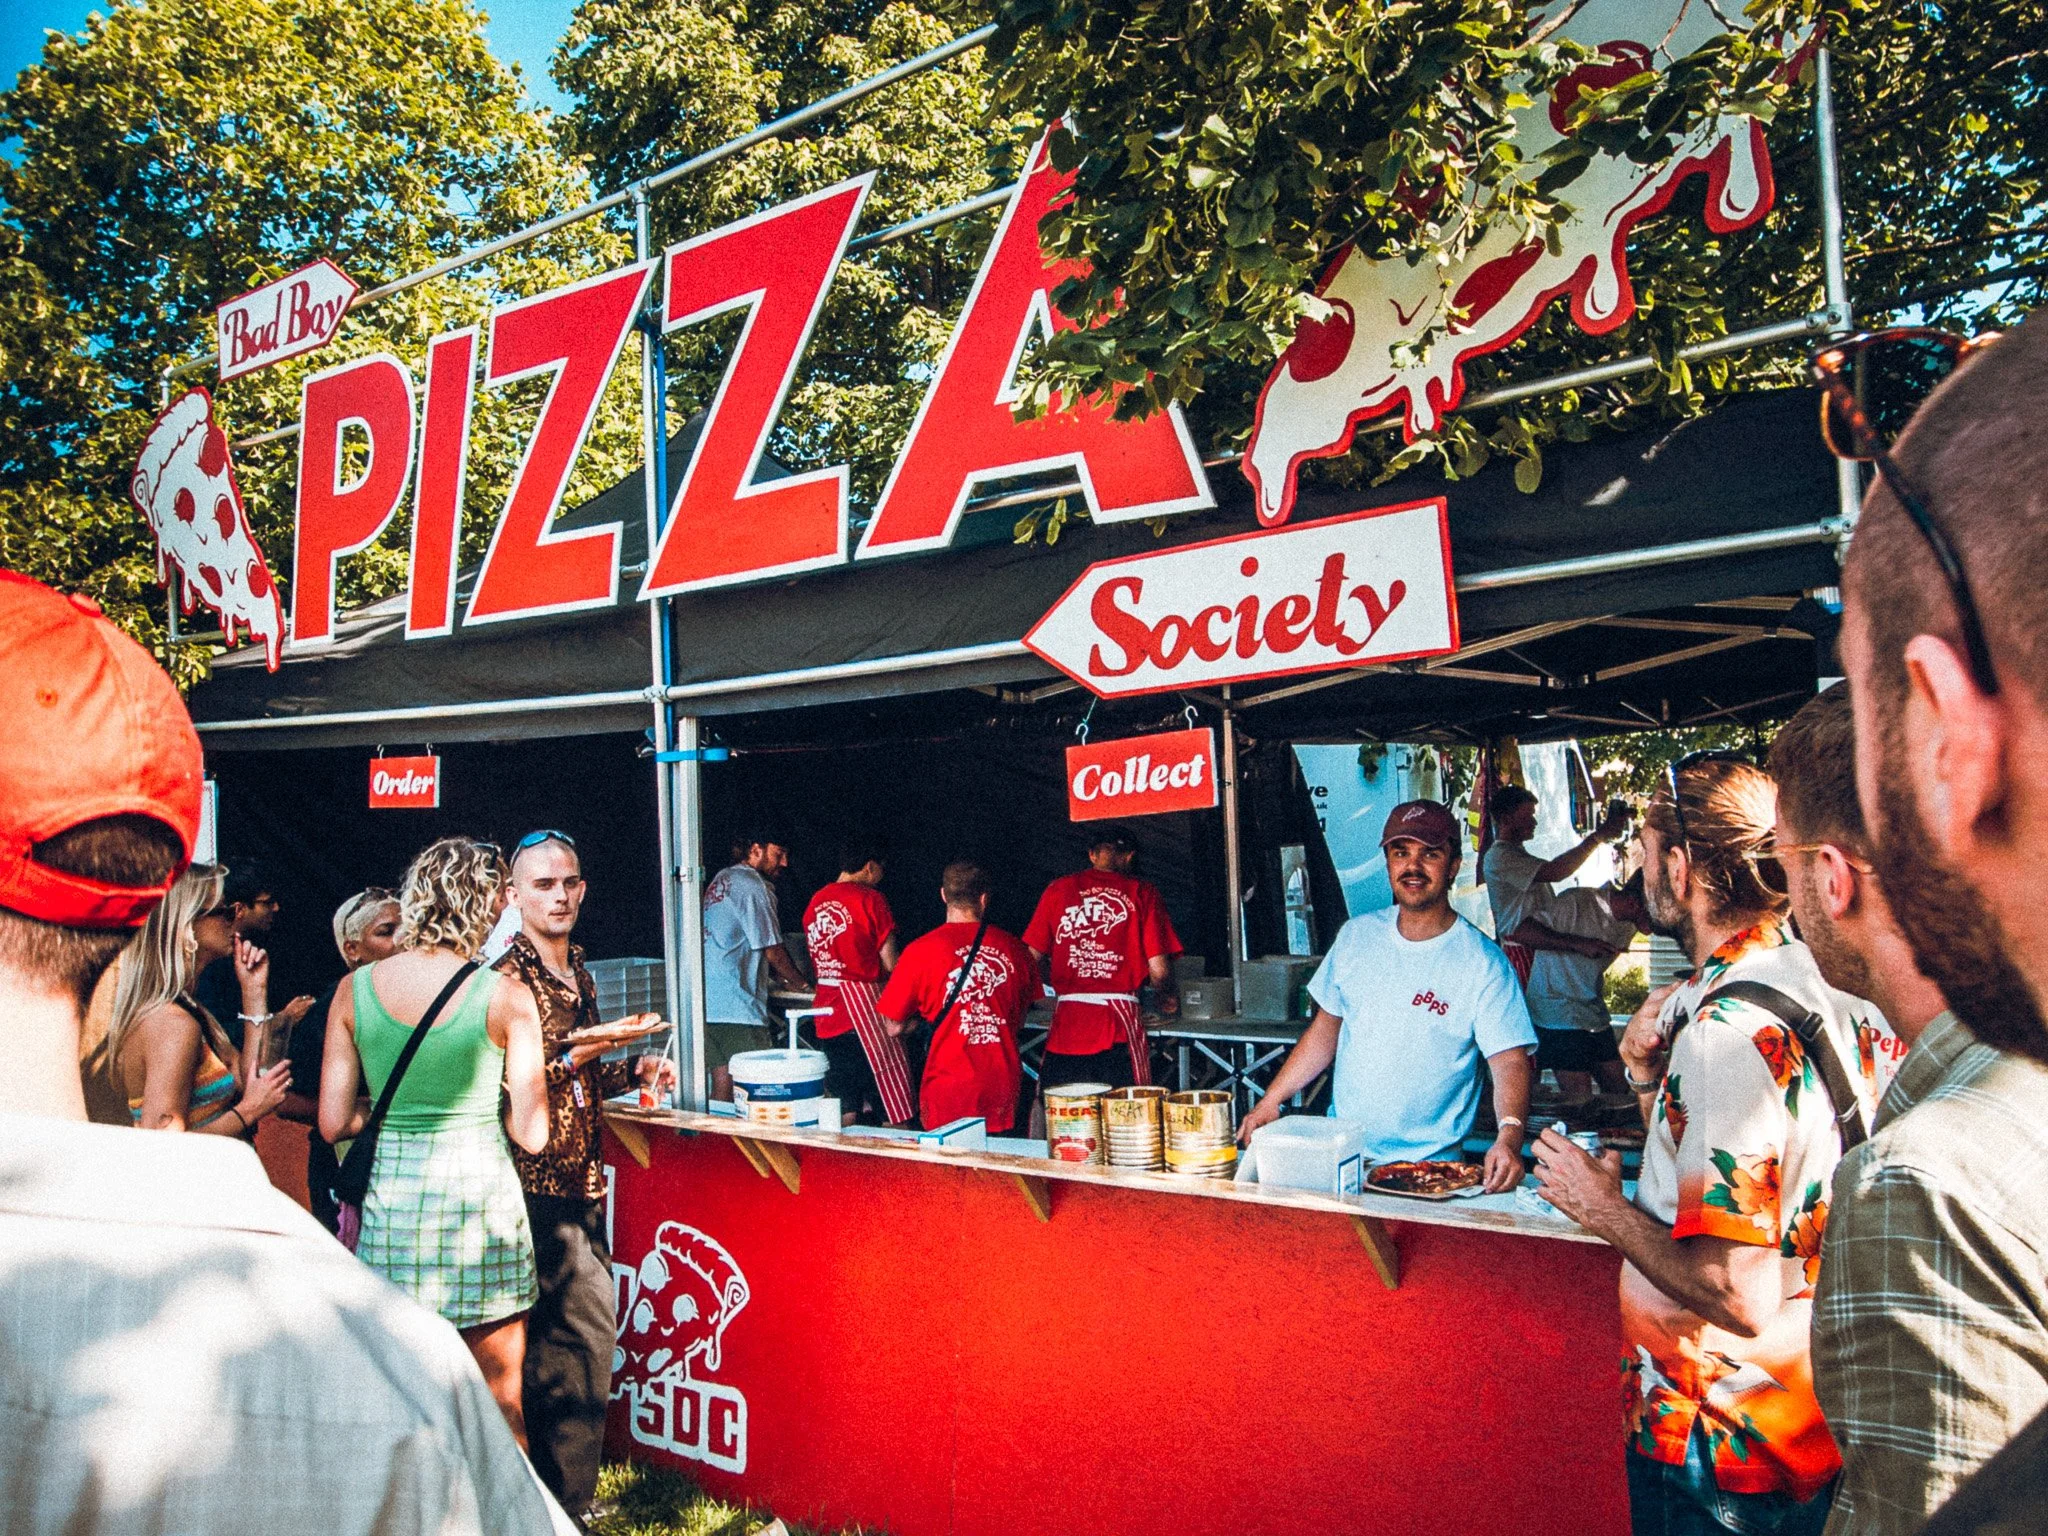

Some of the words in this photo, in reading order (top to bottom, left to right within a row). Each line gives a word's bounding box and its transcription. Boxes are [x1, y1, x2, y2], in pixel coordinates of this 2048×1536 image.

[223, 288, 284, 368] Bad
[283, 279, 343, 340] Boy
[289, 113, 1217, 649] PIZZA
[1088, 551, 1408, 678] Society
[372, 768, 435, 796] Order
[1071, 752, 1206, 803] Collect
[1060, 896, 1105, 933] STAFF
[1411, 990, 1449, 1016] BBPS
